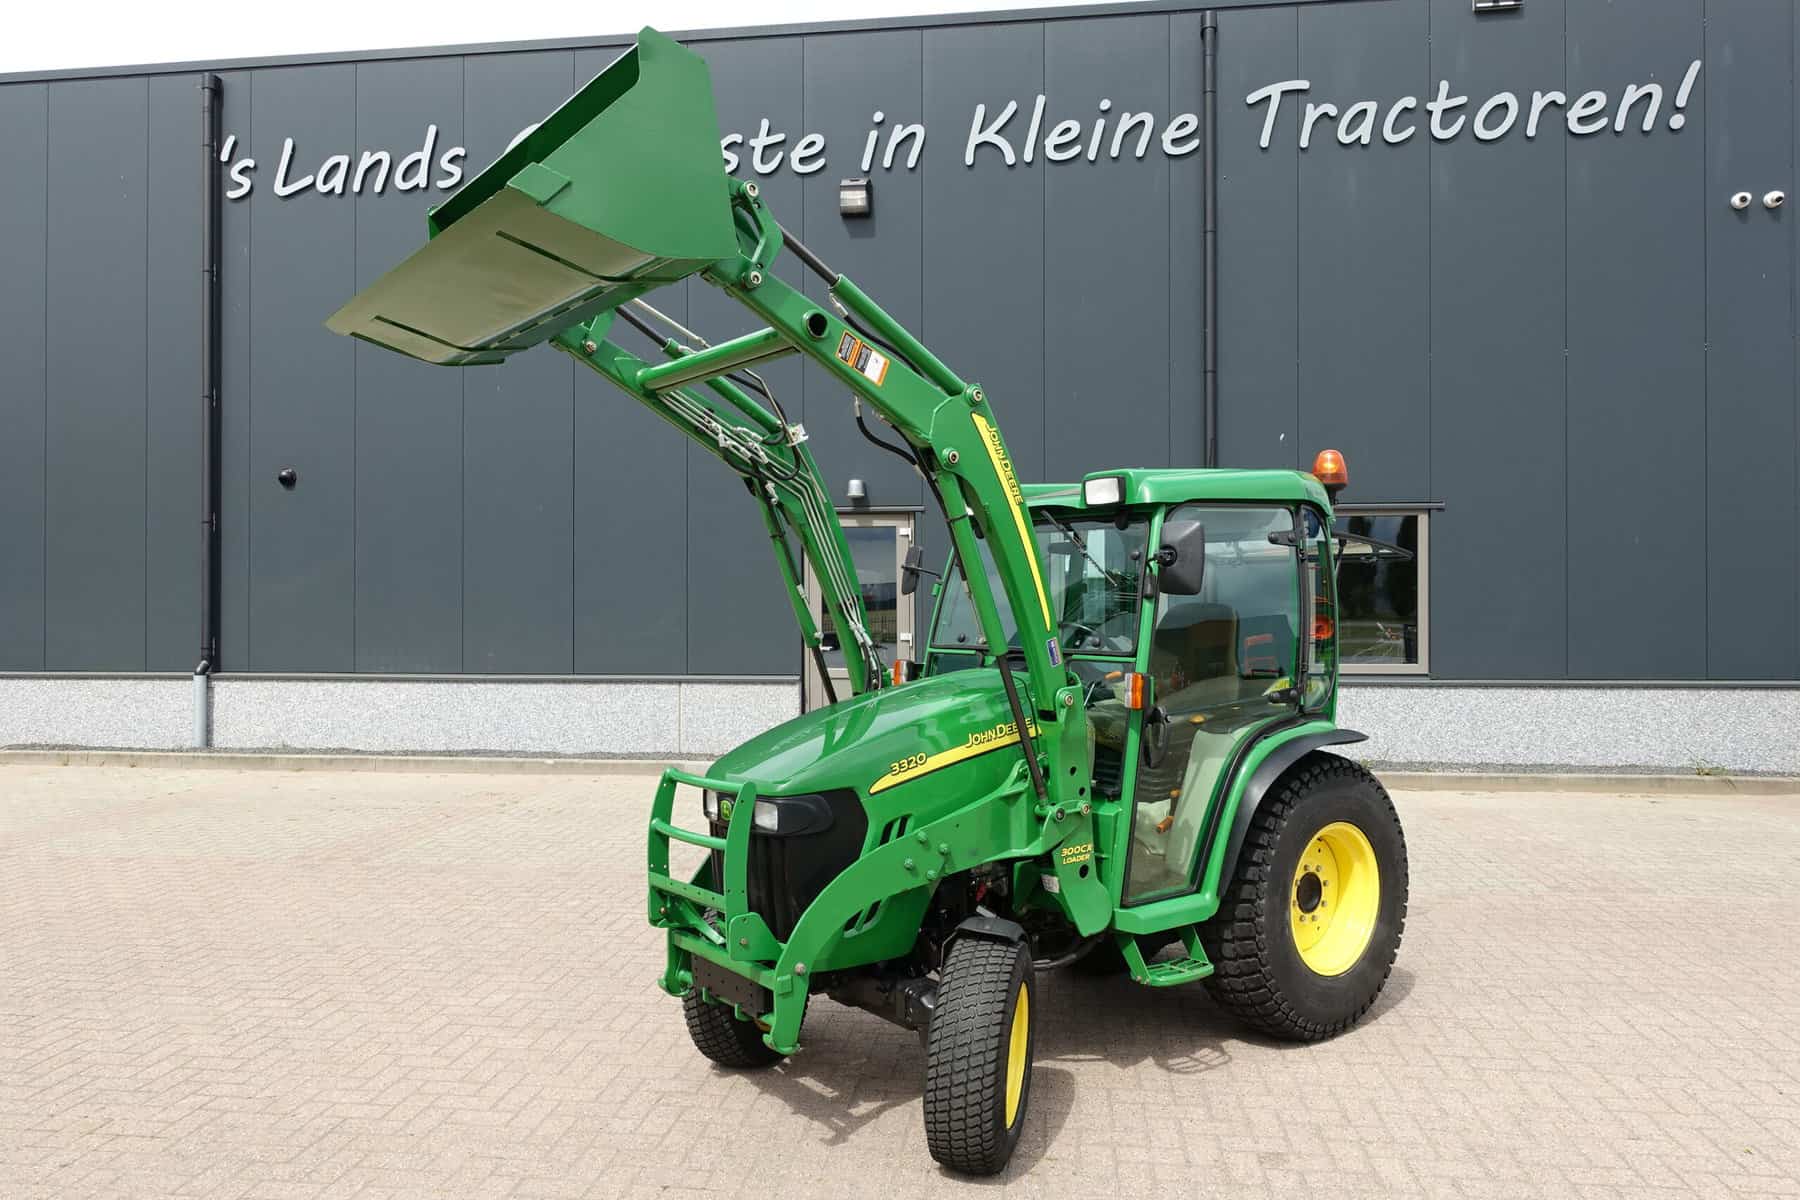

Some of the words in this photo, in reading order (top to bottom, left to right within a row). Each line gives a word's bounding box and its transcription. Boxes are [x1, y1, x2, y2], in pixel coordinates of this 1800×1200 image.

[273, 124, 467, 197] Lands
[861, 110, 926, 171] in
[964, 94, 1200, 167] Kleine
[1246, 60, 1702, 149] Tractoren!
[995, 717, 1034, 738] DEEE
[889, 752, 928, 776] 3320
[1061, 854, 1091, 865] LOADER
